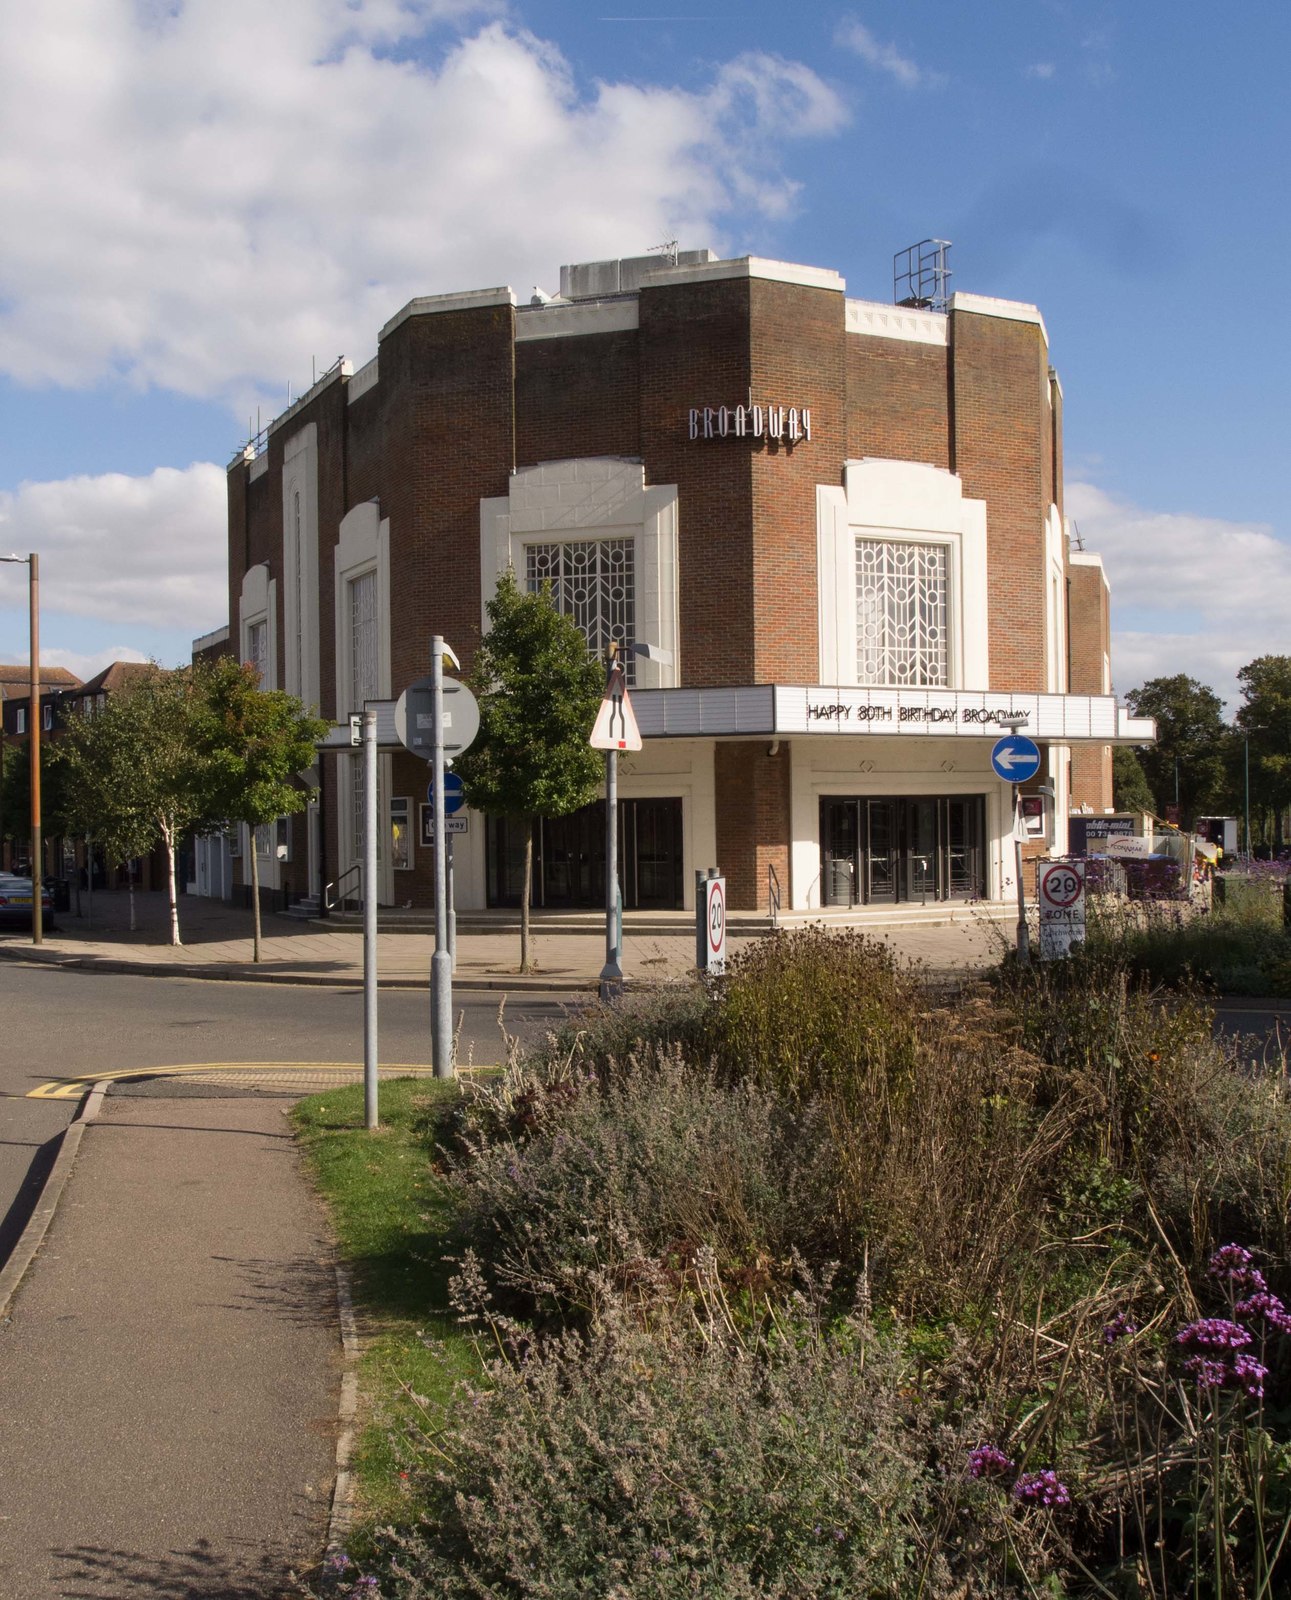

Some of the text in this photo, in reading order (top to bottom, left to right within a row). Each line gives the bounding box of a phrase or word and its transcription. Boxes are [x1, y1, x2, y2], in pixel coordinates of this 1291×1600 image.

[689, 405, 811, 441] BROADWAY
[808, 704, 852, 719] HAPPY
[858, 706, 892, 720] 80TH
[900, 707, 957, 722] BIRTHDAY
[1050, 877, 1076, 893] 20
[712, 903, 721, 930] 20
[1046, 910, 1079, 919] ZONE
